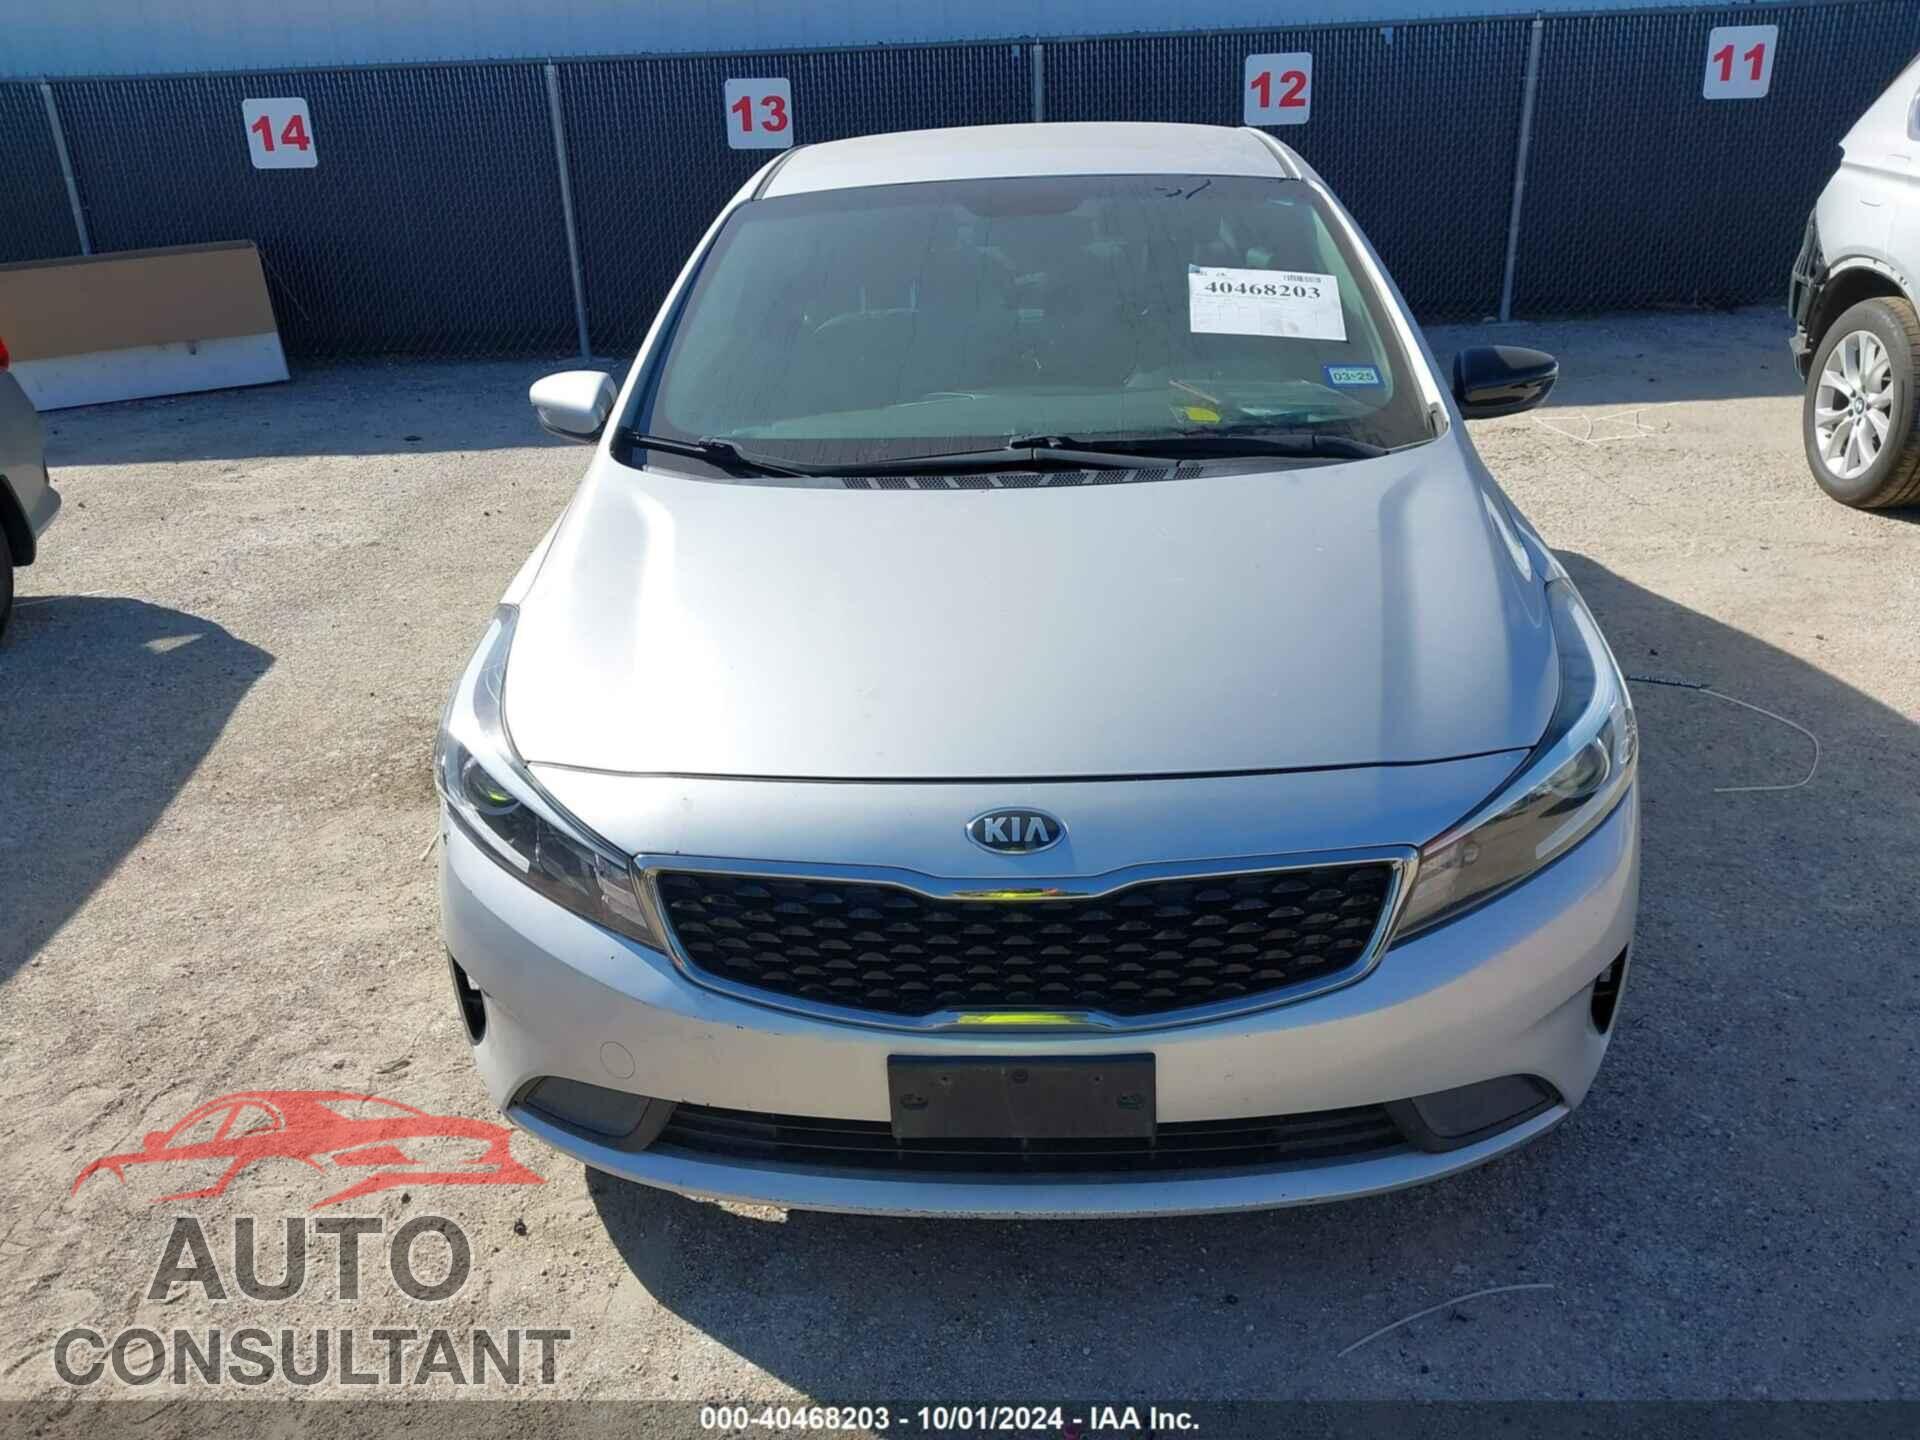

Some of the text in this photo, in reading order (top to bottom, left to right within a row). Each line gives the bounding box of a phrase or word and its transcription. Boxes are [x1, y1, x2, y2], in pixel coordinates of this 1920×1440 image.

[1713, 43, 1766, 82] 11
[1250, 70, 1307, 108] 12
[732, 95, 788, 132] 13
[252, 115, 310, 151] 14
[1204, 280, 1321, 299] 40468203
[984, 816, 1050, 843] KIA
